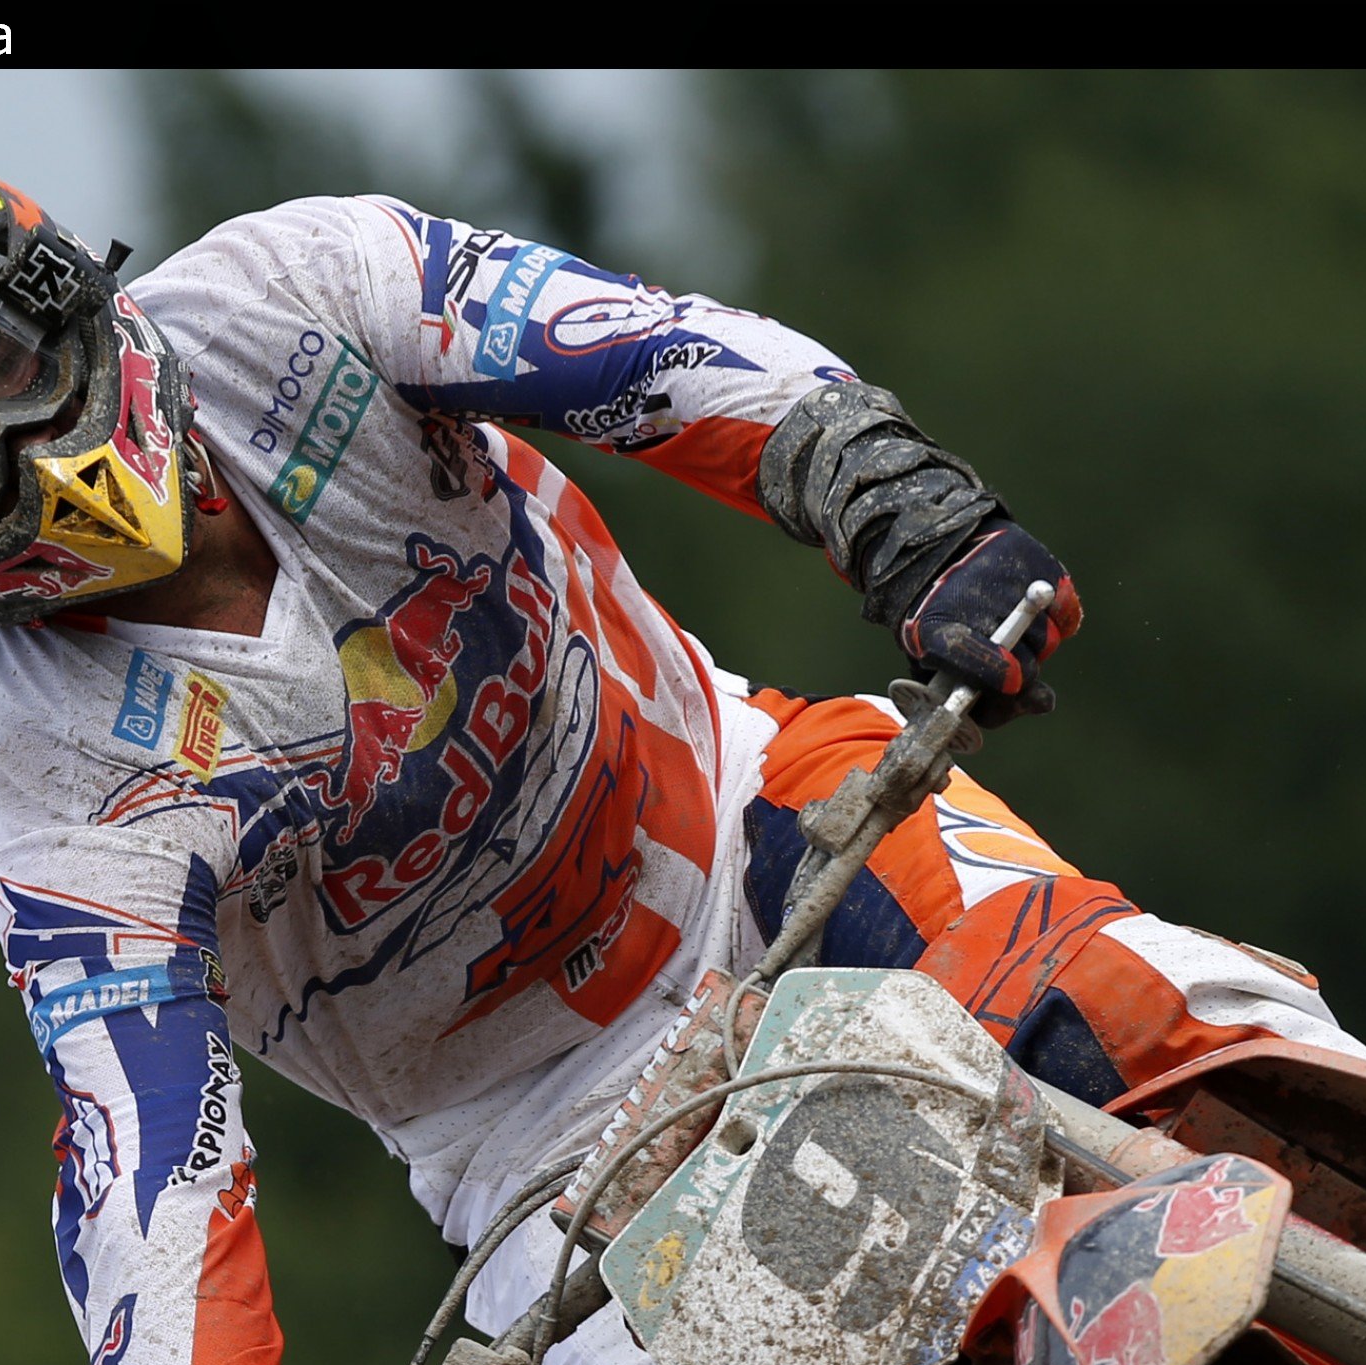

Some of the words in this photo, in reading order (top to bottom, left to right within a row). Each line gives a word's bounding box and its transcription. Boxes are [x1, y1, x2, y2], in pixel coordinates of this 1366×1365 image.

[249, 330, 325, 454] DIMOCO
[323, 750, 495, 926] Red
[464, 553, 556, 768] Bull
